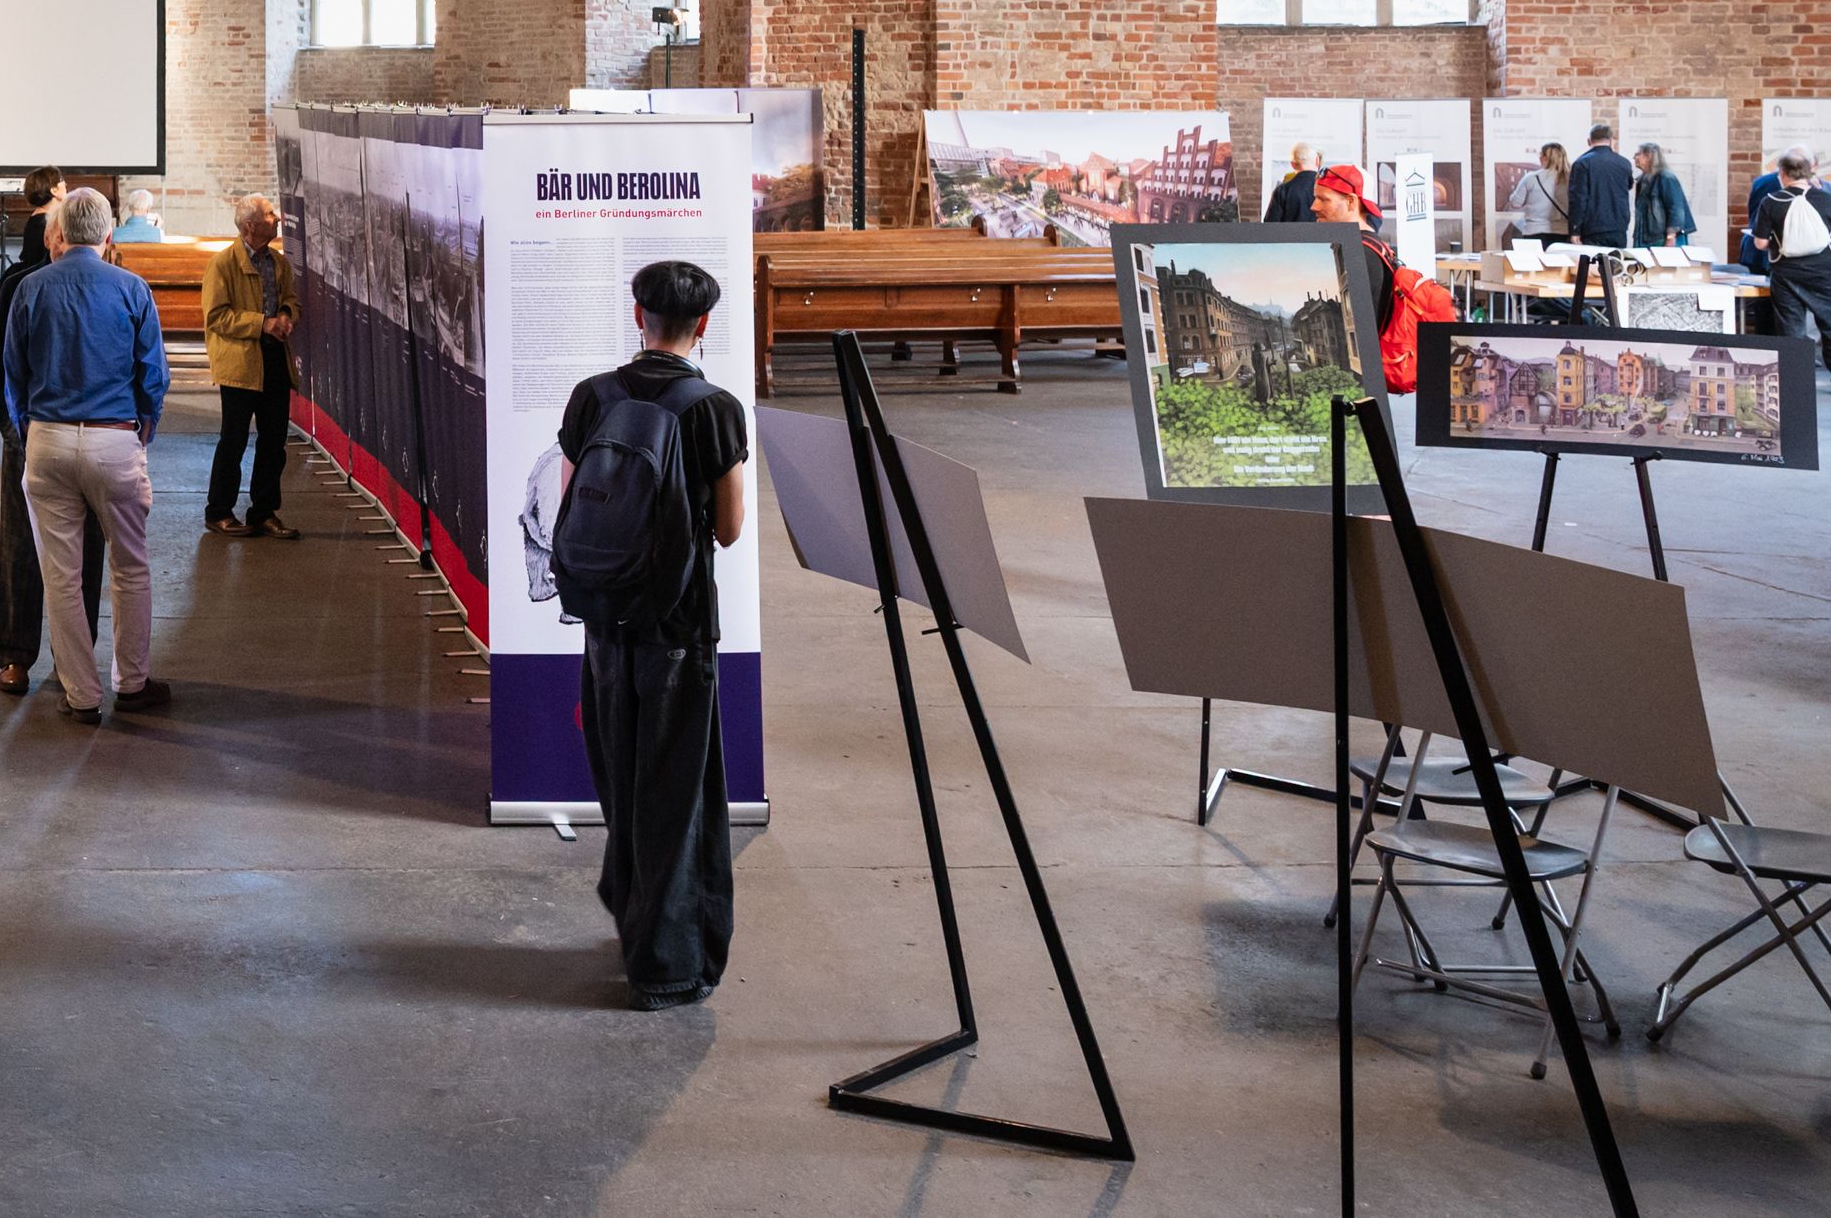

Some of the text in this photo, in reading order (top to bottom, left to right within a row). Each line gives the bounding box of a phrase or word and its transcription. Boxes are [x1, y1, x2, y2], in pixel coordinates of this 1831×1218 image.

[537, 168, 700, 201] BÄR UND BEROLINA
[536, 208, 702, 219] ein Berliner Gründungsmärchen
[1406, 192, 1427, 216] GHB
